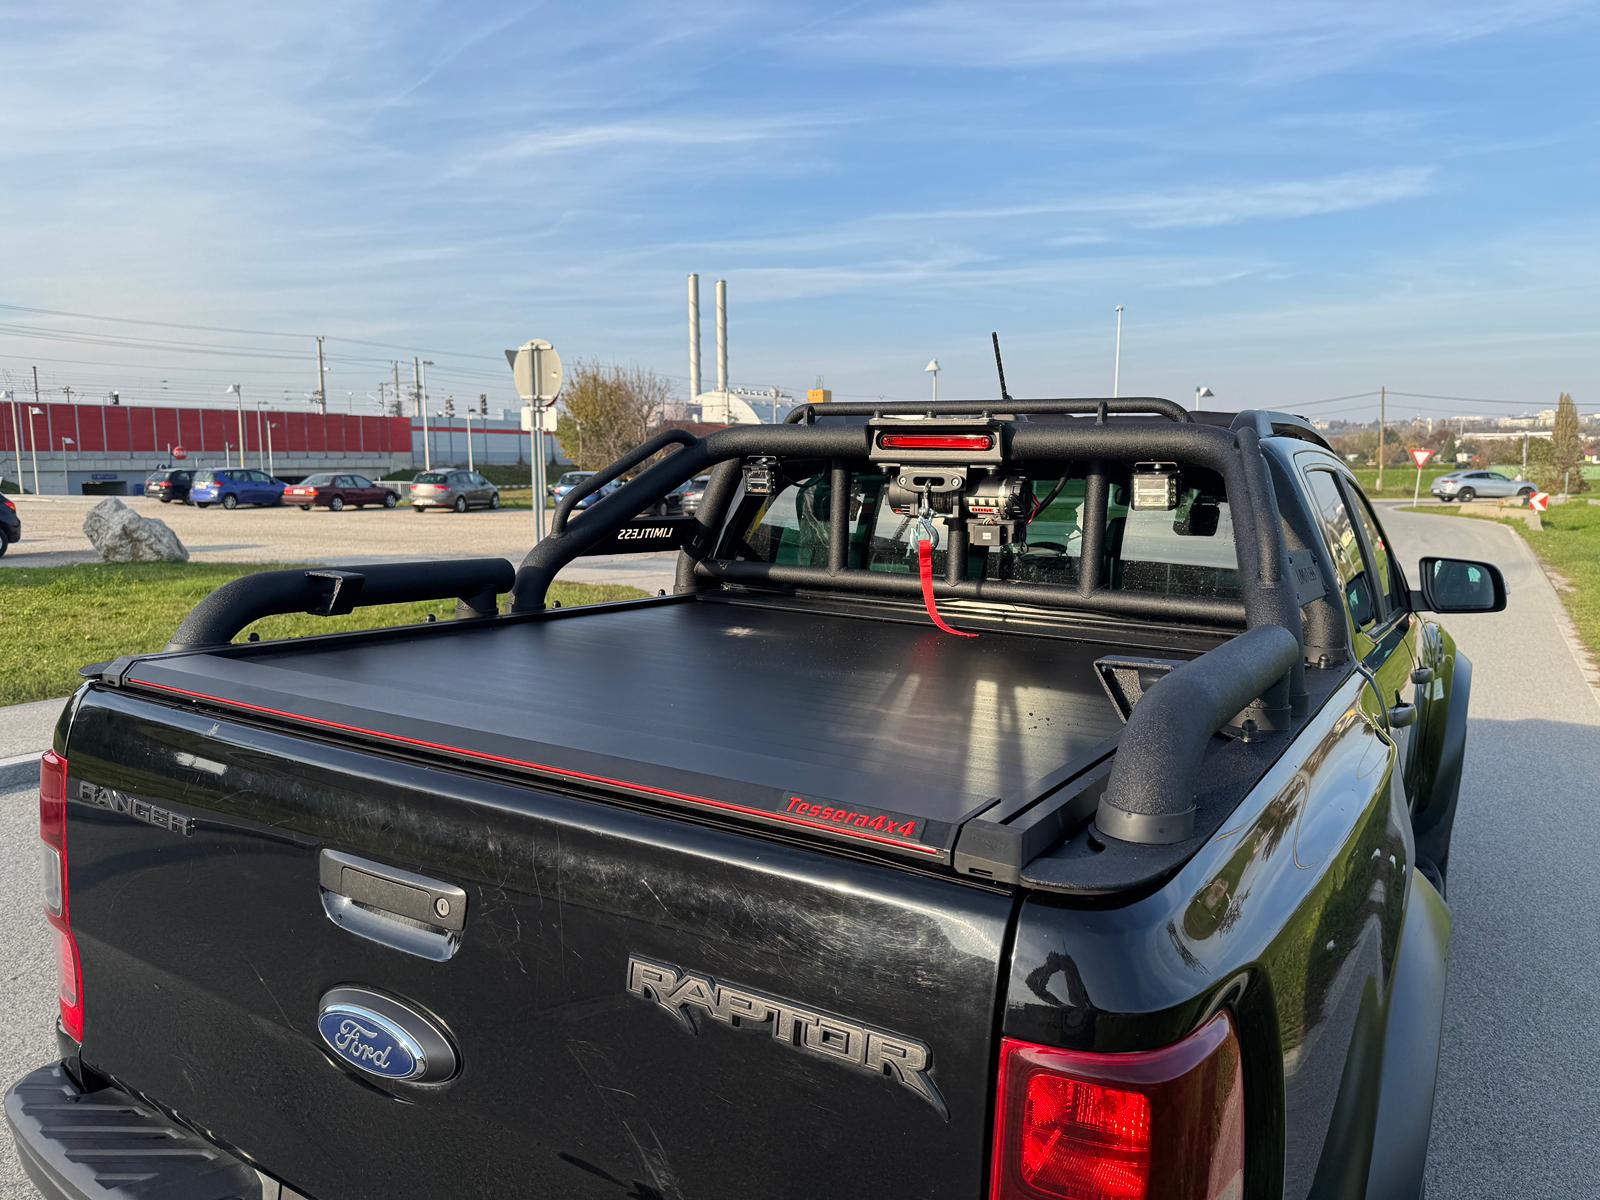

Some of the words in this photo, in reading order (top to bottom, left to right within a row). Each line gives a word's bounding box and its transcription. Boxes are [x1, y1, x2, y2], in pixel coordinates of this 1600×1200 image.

[76, 780, 197, 837] RANGER
[785, 794, 917, 839] Tessera4x4
[333, 1018, 391, 1071] Ford
[625, 951, 951, 1124] RAPTOR
